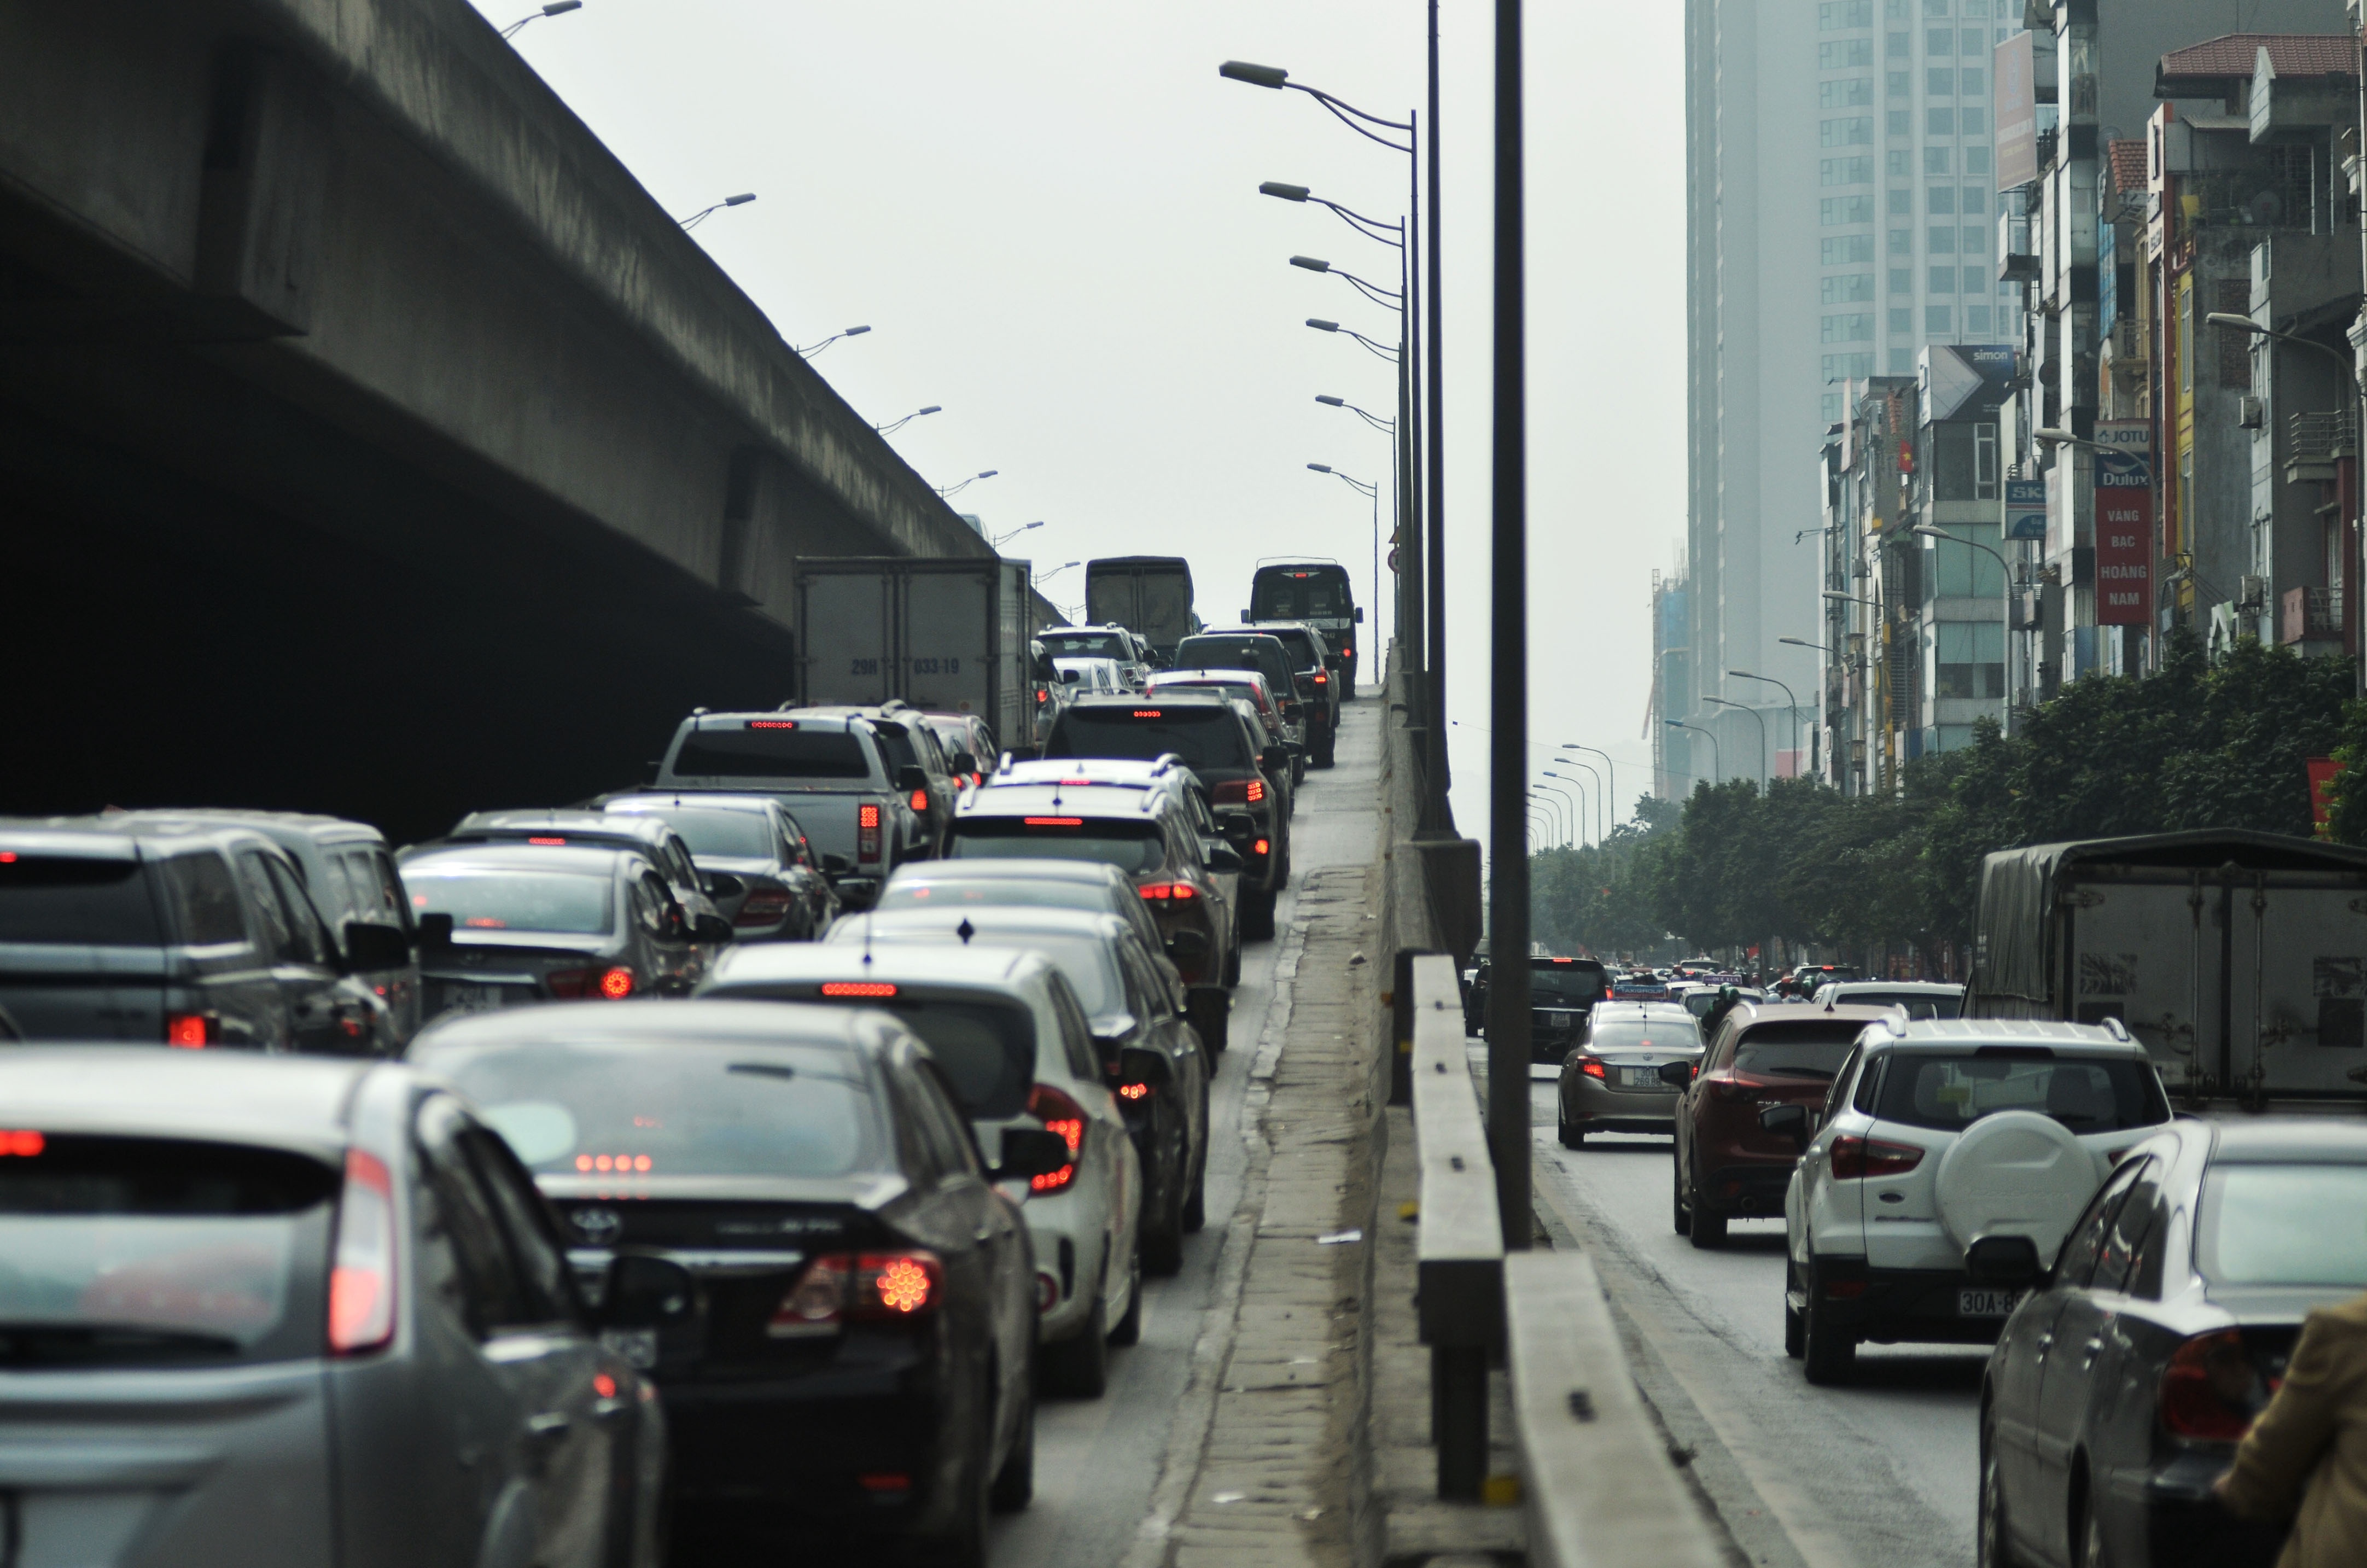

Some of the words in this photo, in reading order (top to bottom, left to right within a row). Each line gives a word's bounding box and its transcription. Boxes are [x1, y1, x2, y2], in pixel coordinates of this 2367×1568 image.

[1973, 349, 2008, 360] simon
[2103, 473, 2148, 486] Dulux
[2013, 486, 2046, 498] SK
[2107, 508, 2139, 522] VÀNG
[2112, 535, 2136, 550] BẠC
[2101, 562, 2147, 579] HOÀNG
[2109, 592, 2139, 605] NAM
[852, 658, 877, 675] 29H
